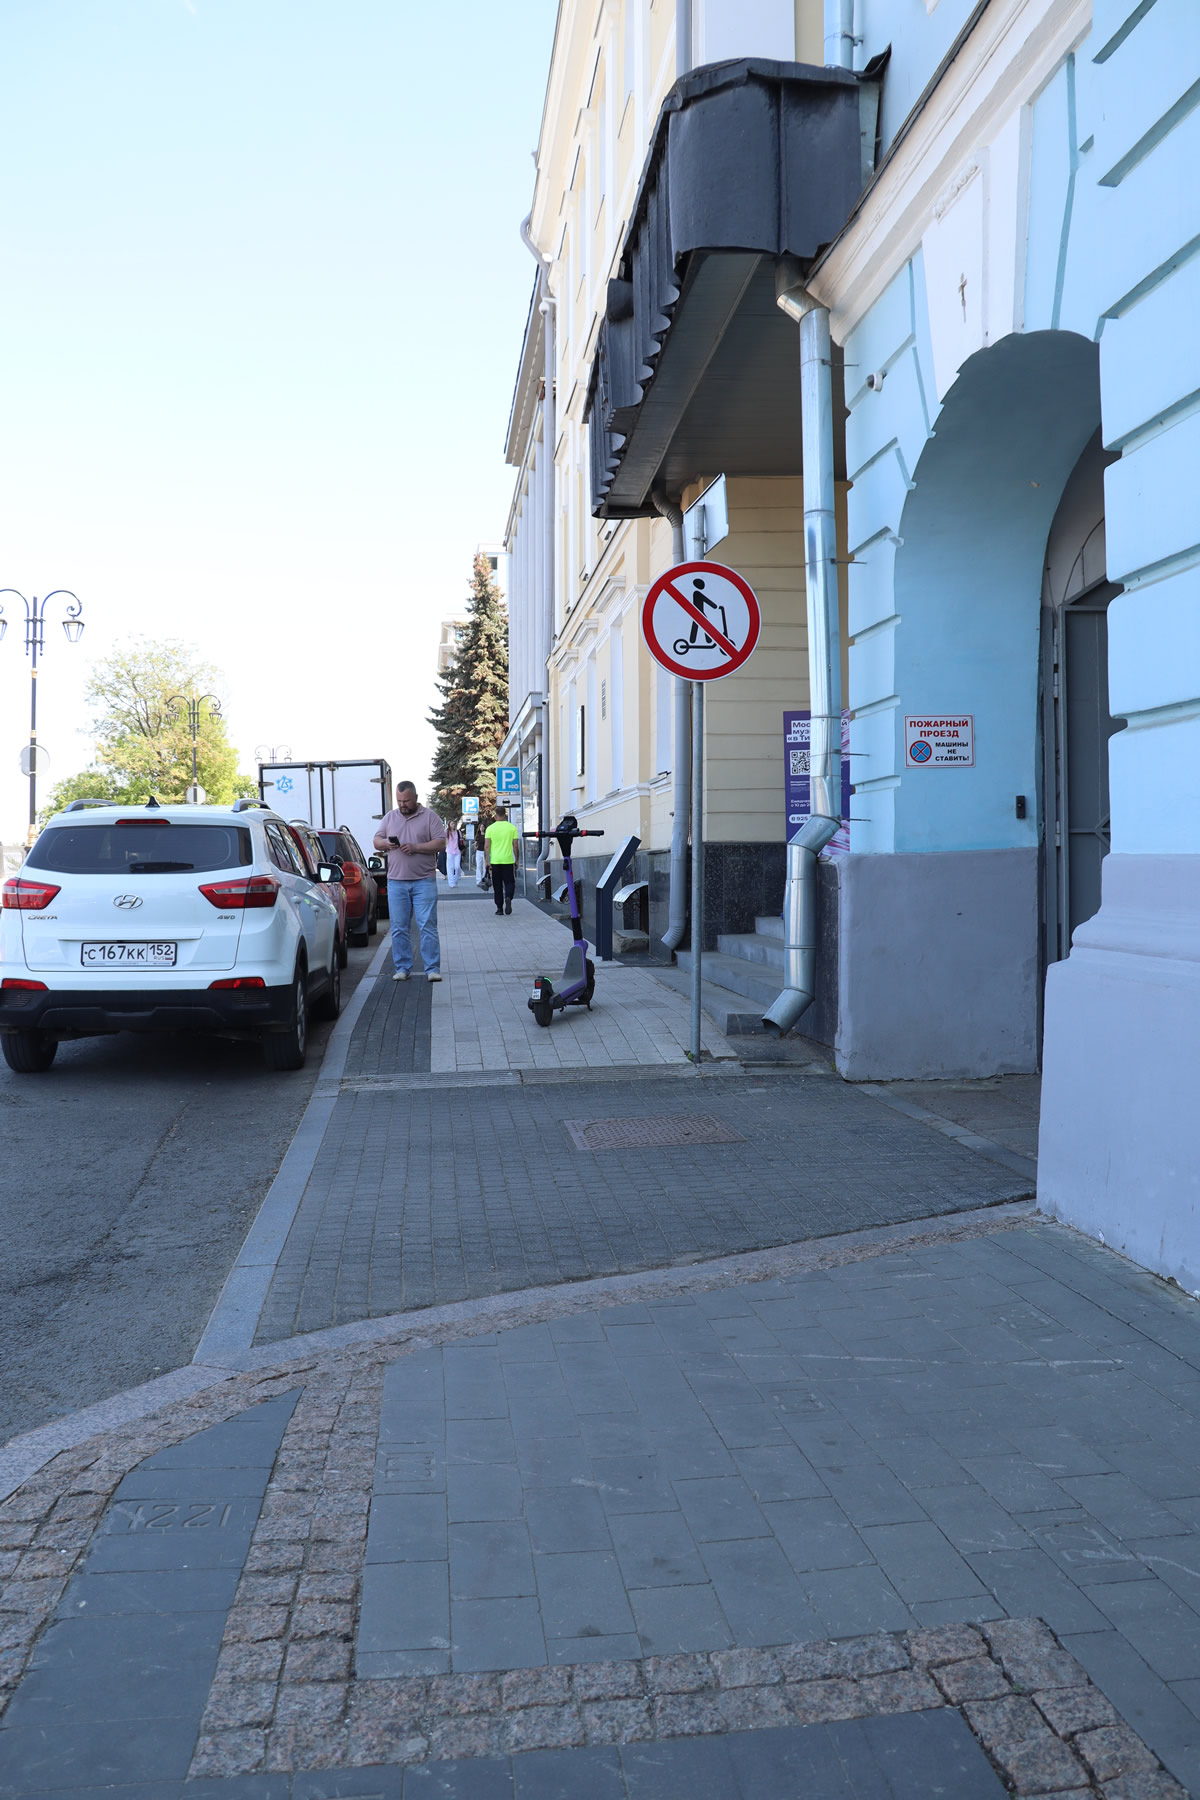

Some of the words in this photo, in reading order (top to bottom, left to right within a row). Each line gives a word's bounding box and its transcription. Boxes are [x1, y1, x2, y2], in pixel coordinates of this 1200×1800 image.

[909, 718, 969, 728] ПОЖАРНЫЙ
[919, 730, 960, 738] ПРОЕЗД
[501, 769, 516, 790] P
[465, 798, 475, 812] P
[149, 944, 171, 956] 152
